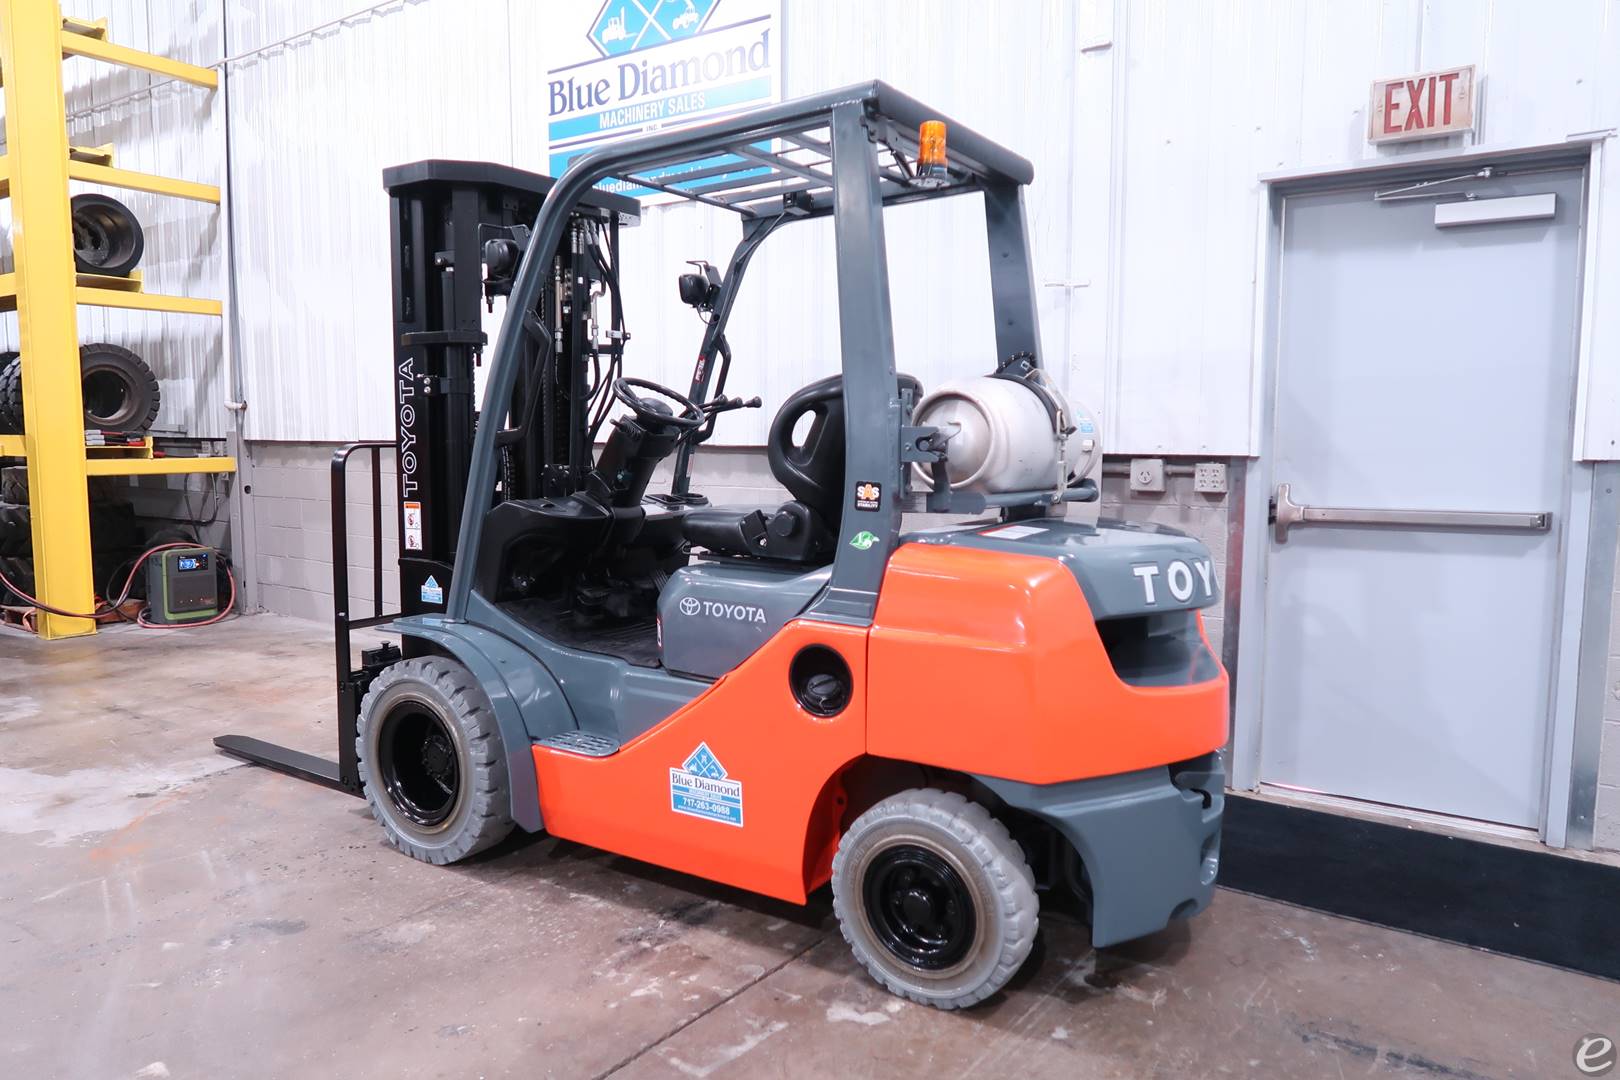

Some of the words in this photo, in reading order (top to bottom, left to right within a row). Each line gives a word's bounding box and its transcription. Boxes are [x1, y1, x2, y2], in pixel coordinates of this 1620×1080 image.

[548, 76, 611, 116] Blue
[617, 27, 771, 101] Diamond
[599, 101, 665, 129] MACHINERY
[667, 92, 706, 115] SALES
[1384, 72, 1460, 134] EXIT
[399, 357, 418, 498] TOYOTA
[857, 483, 880, 500] SAS
[1133, 560, 1213, 604] TOY
[703, 601, 767, 623] TOYOTA
[672, 773, 693, 786] Blue
[694, 777, 740, 797] Diamond
